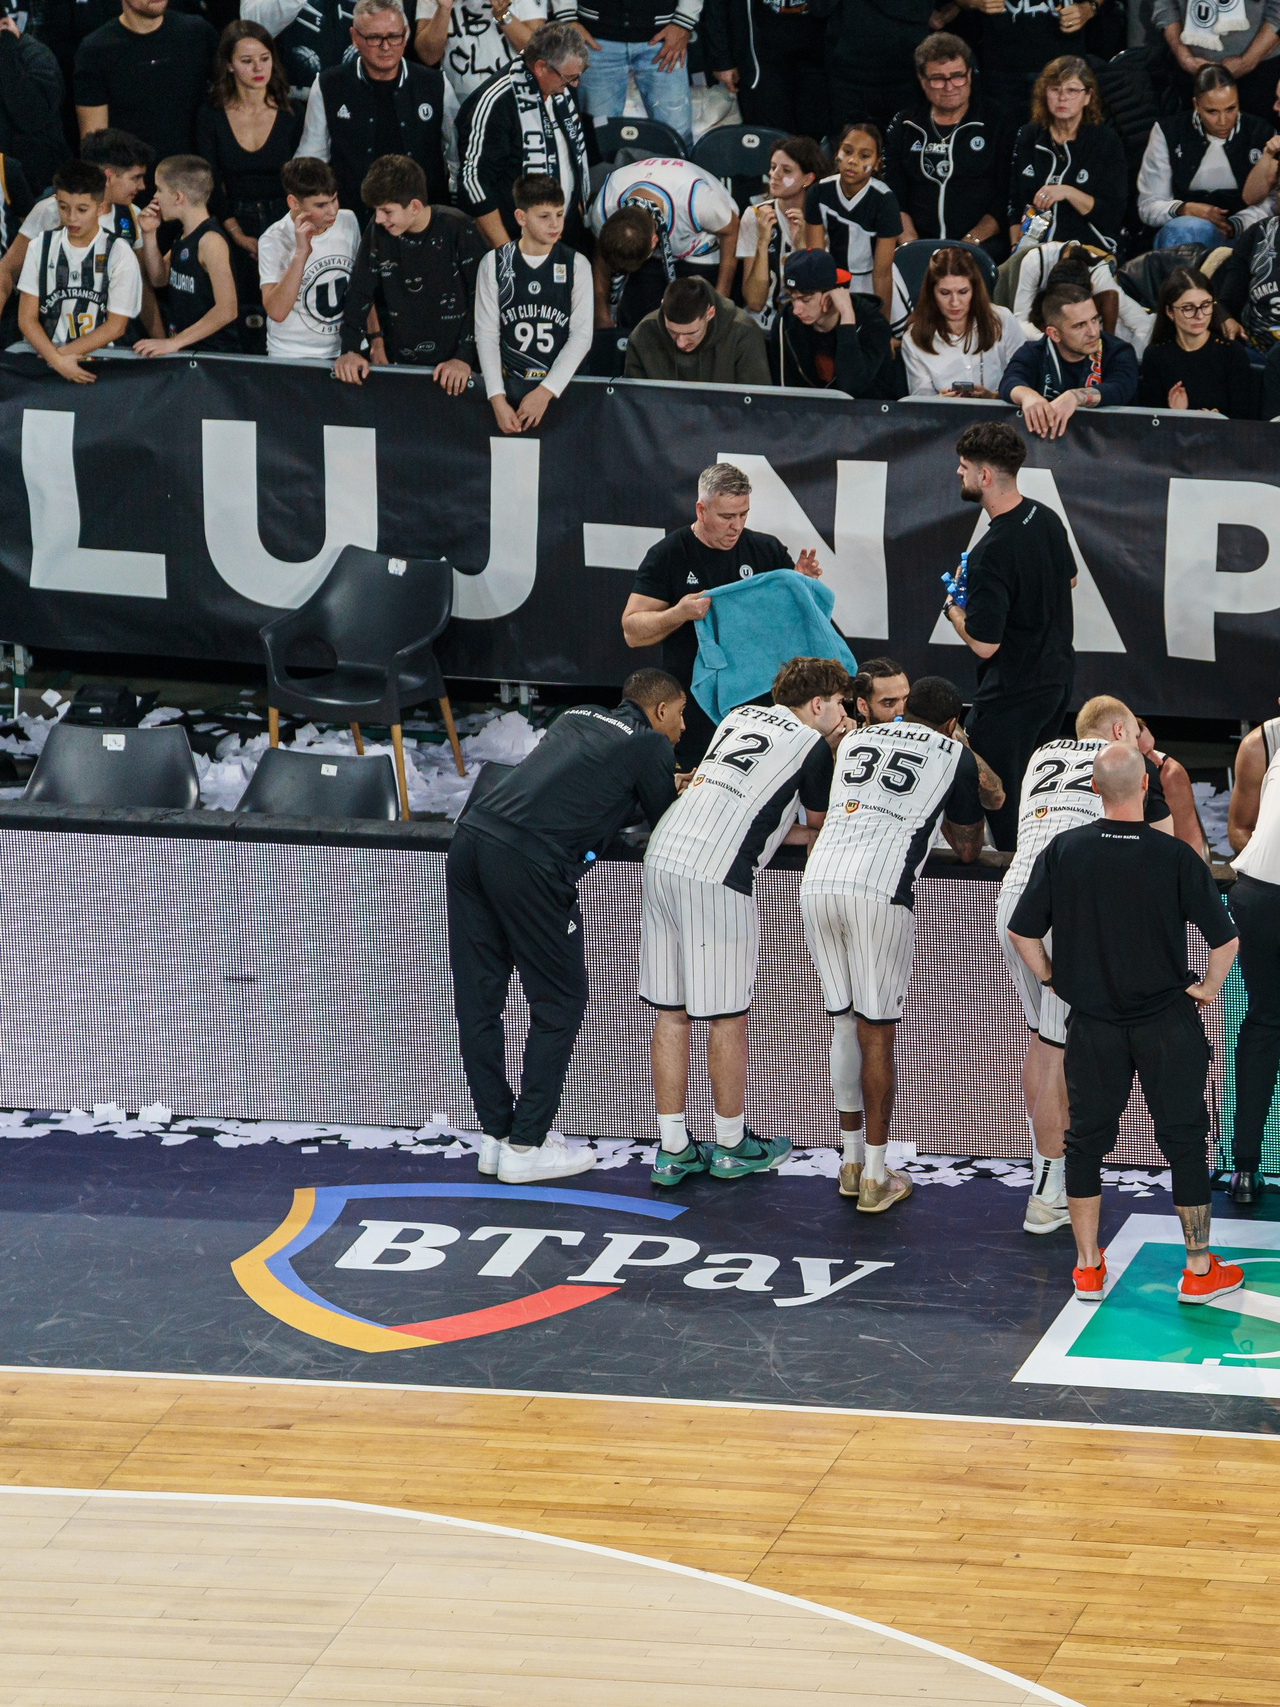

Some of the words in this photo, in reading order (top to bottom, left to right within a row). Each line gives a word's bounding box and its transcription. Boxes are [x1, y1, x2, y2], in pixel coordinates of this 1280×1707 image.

[316, 276, 348, 319] U
[514, 322, 555, 353] 95
[732, 707, 799, 732] ETRIC
[702, 725, 774, 777] 12
[938, 738, 955, 754] II
[841, 743, 928, 797] 35
[1027, 757, 1101, 802] 22
[334, 1219, 896, 1308] BTPay
